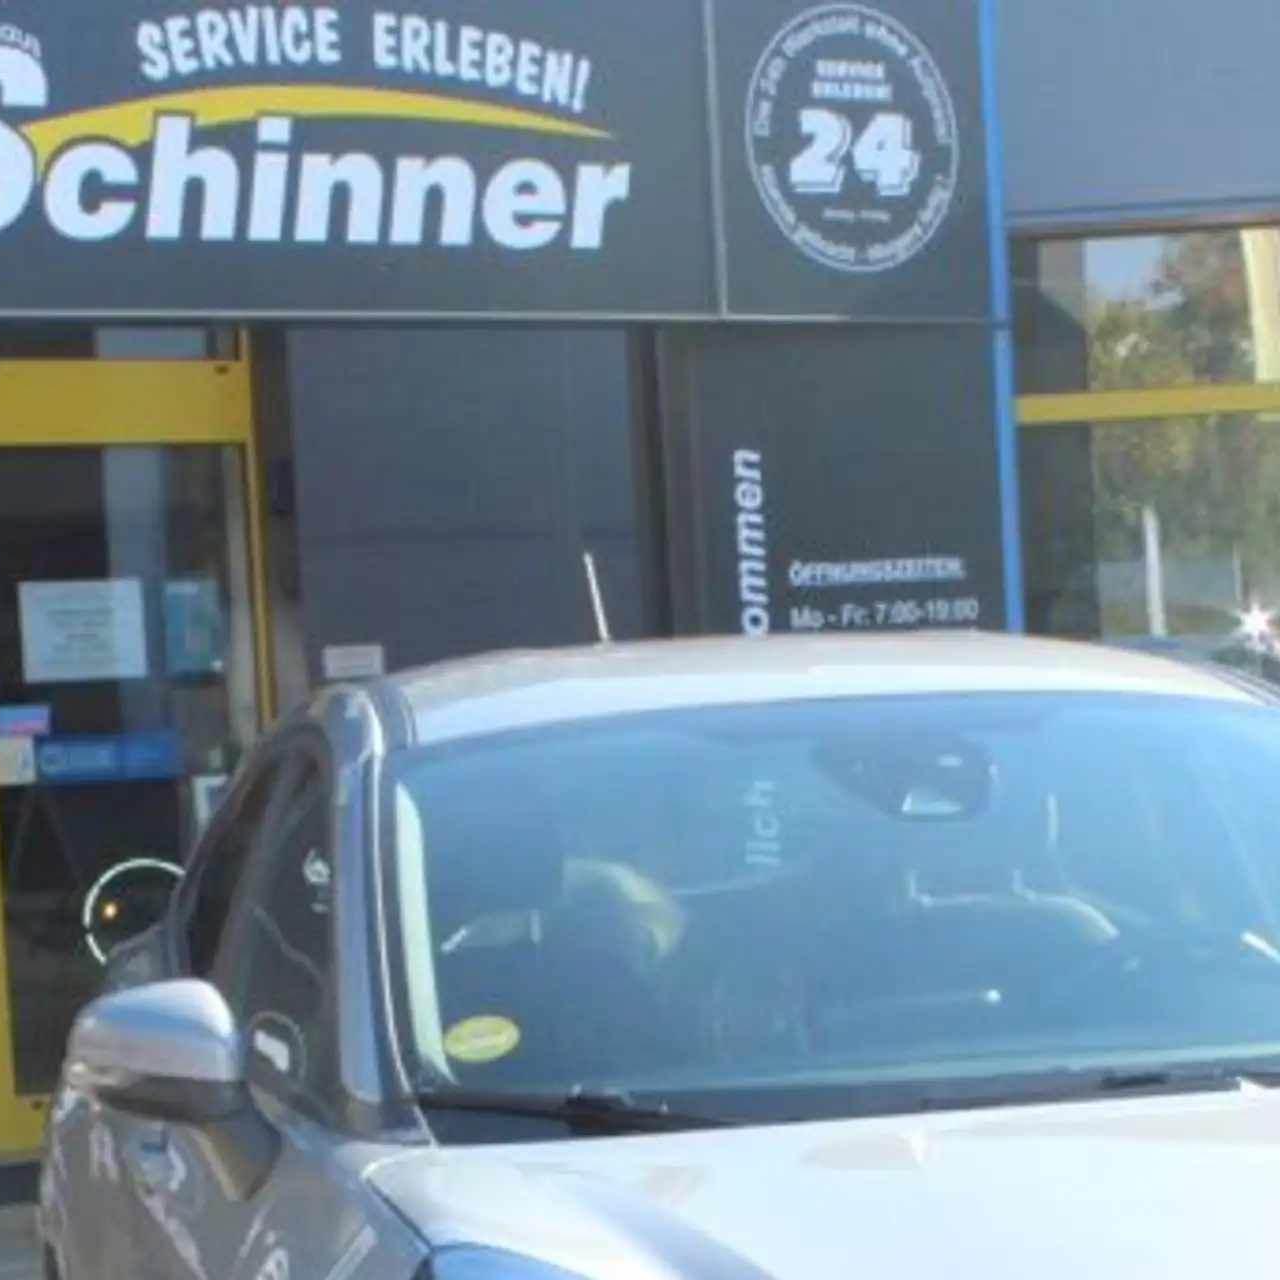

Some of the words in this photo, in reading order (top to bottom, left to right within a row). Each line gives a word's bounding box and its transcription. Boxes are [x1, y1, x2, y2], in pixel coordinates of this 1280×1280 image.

[137, 4, 342, 81] SERVICE
[372, 12, 591, 112] ERLEBEN!
[789, 108, 921, 196] 24
[733, 449, 769, 636] ommen
